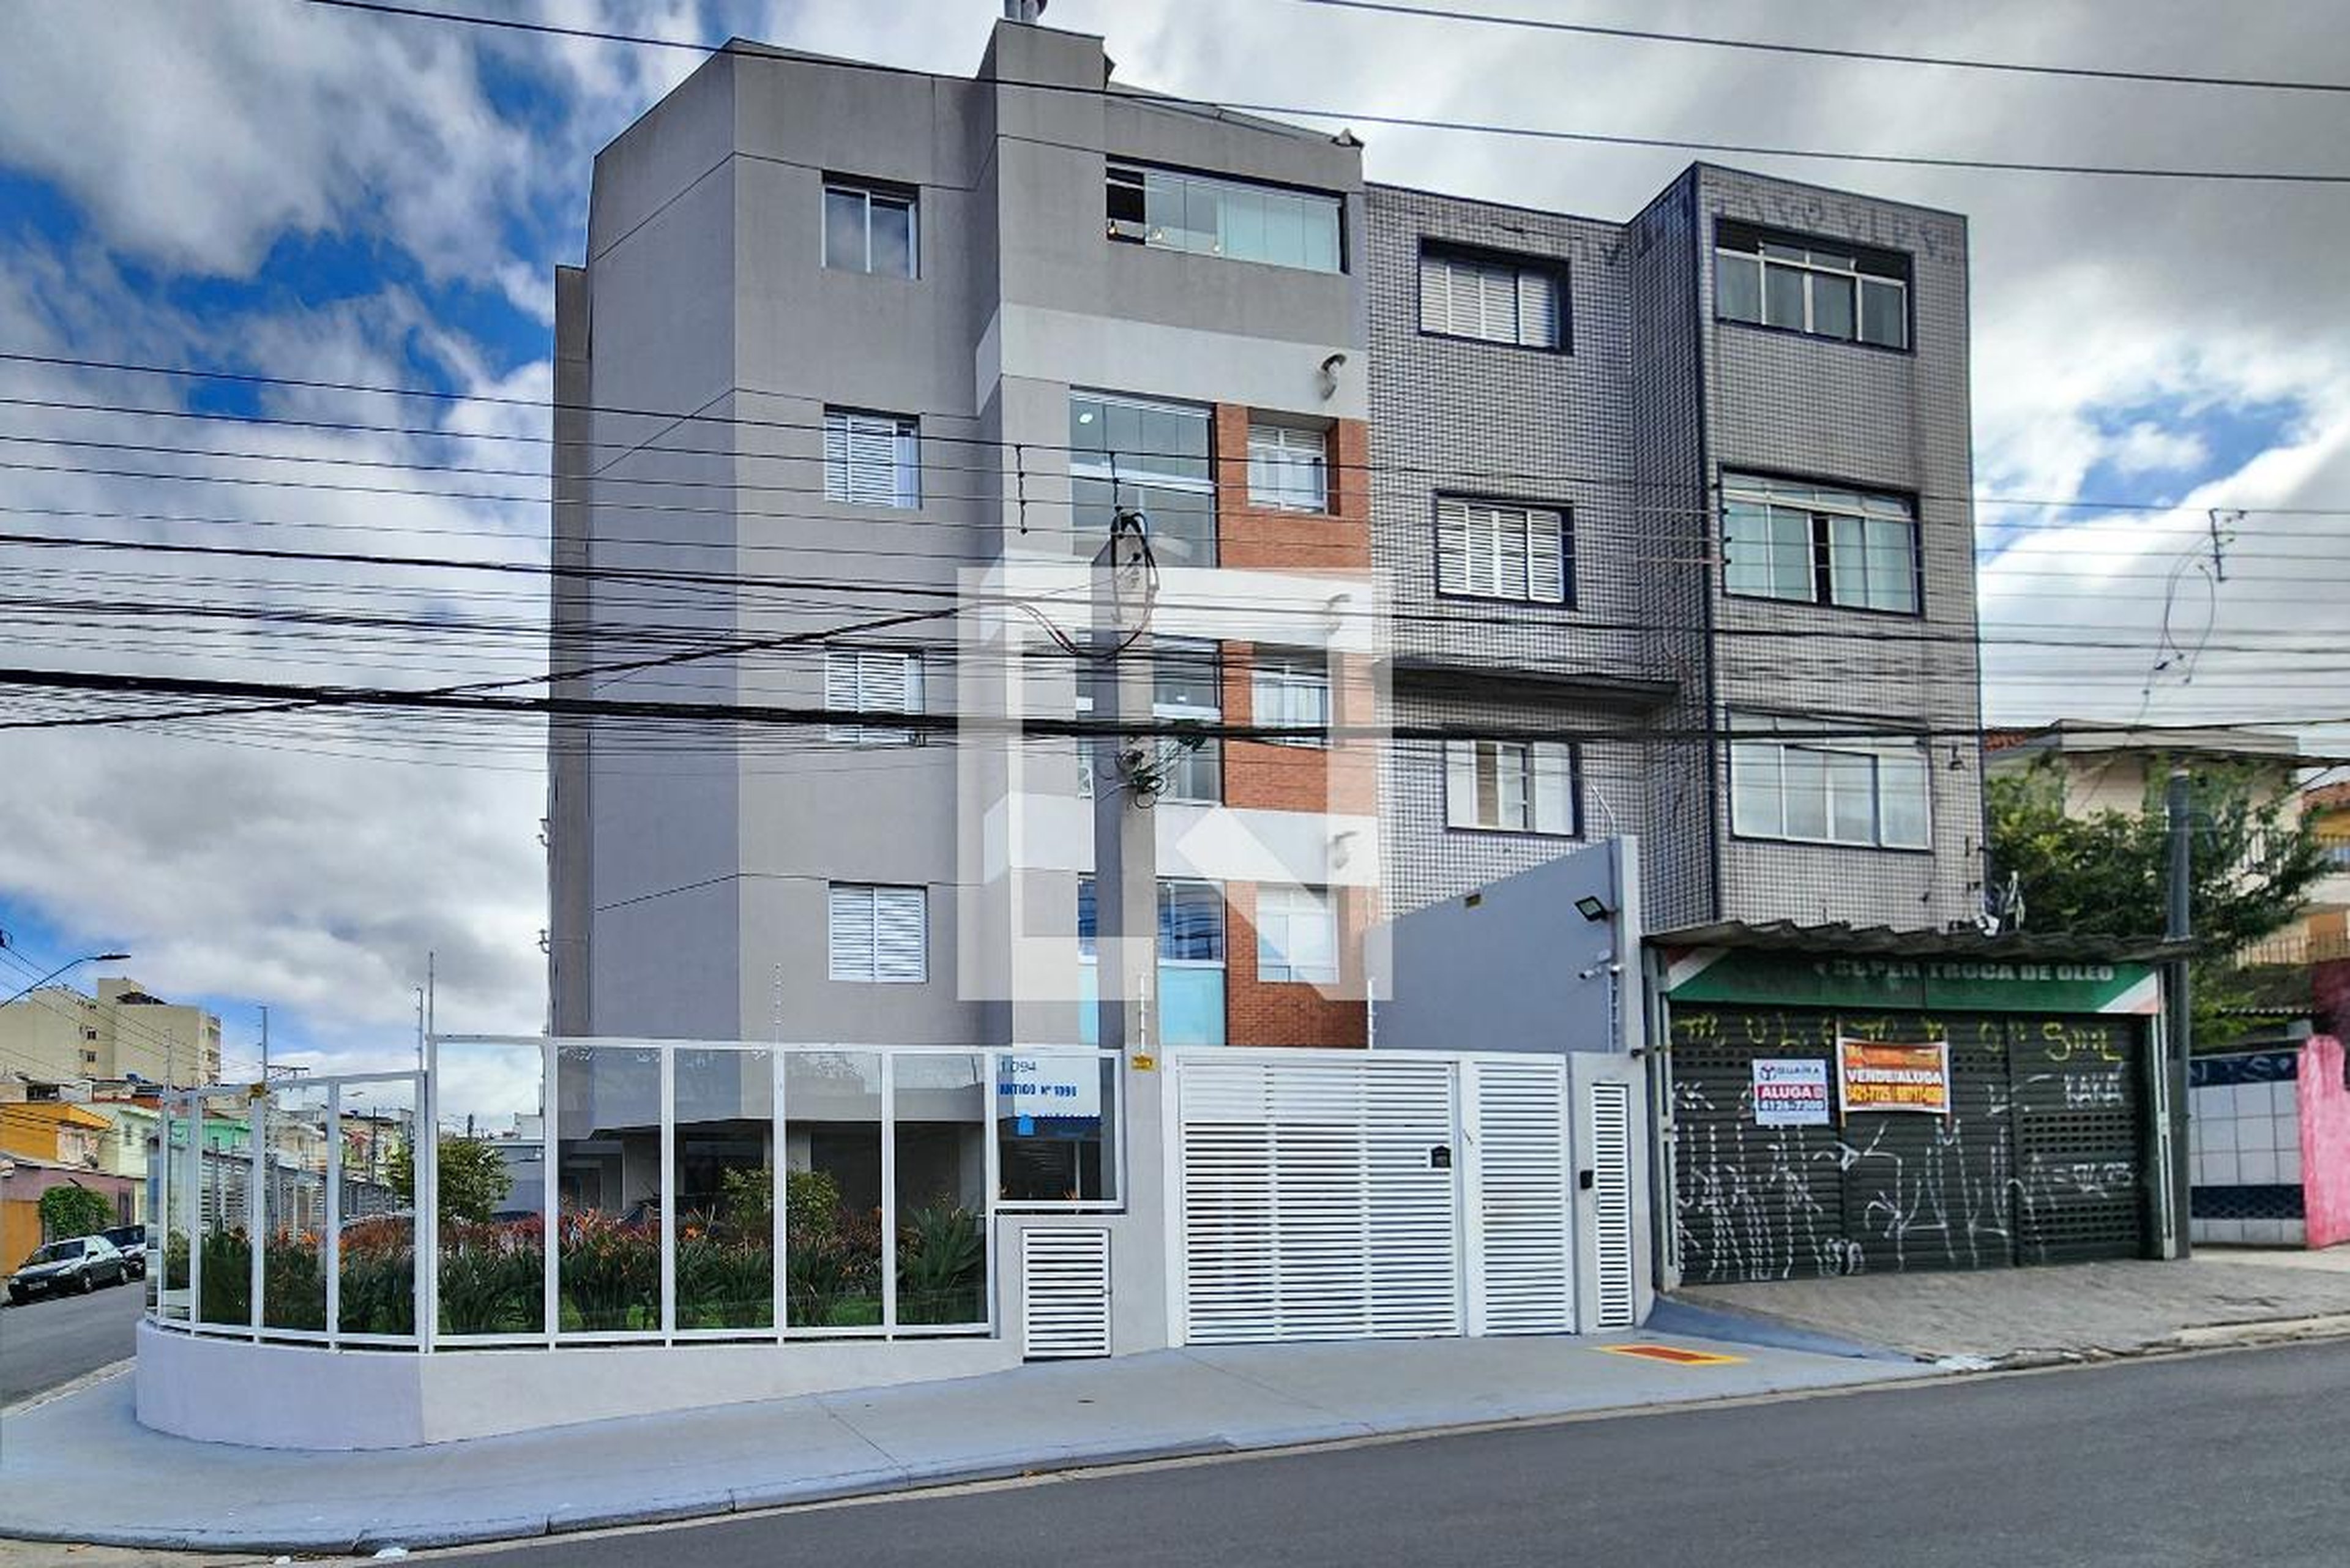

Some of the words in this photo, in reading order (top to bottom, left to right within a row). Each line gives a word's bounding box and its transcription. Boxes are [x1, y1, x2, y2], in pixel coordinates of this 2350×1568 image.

[1929, 962, 2015, 979] TROCA
[2020, 964, 2050, 980] DE
[2056, 965, 2114, 980] OLEO
[1761, 1086, 1813, 1099] ALUGA
